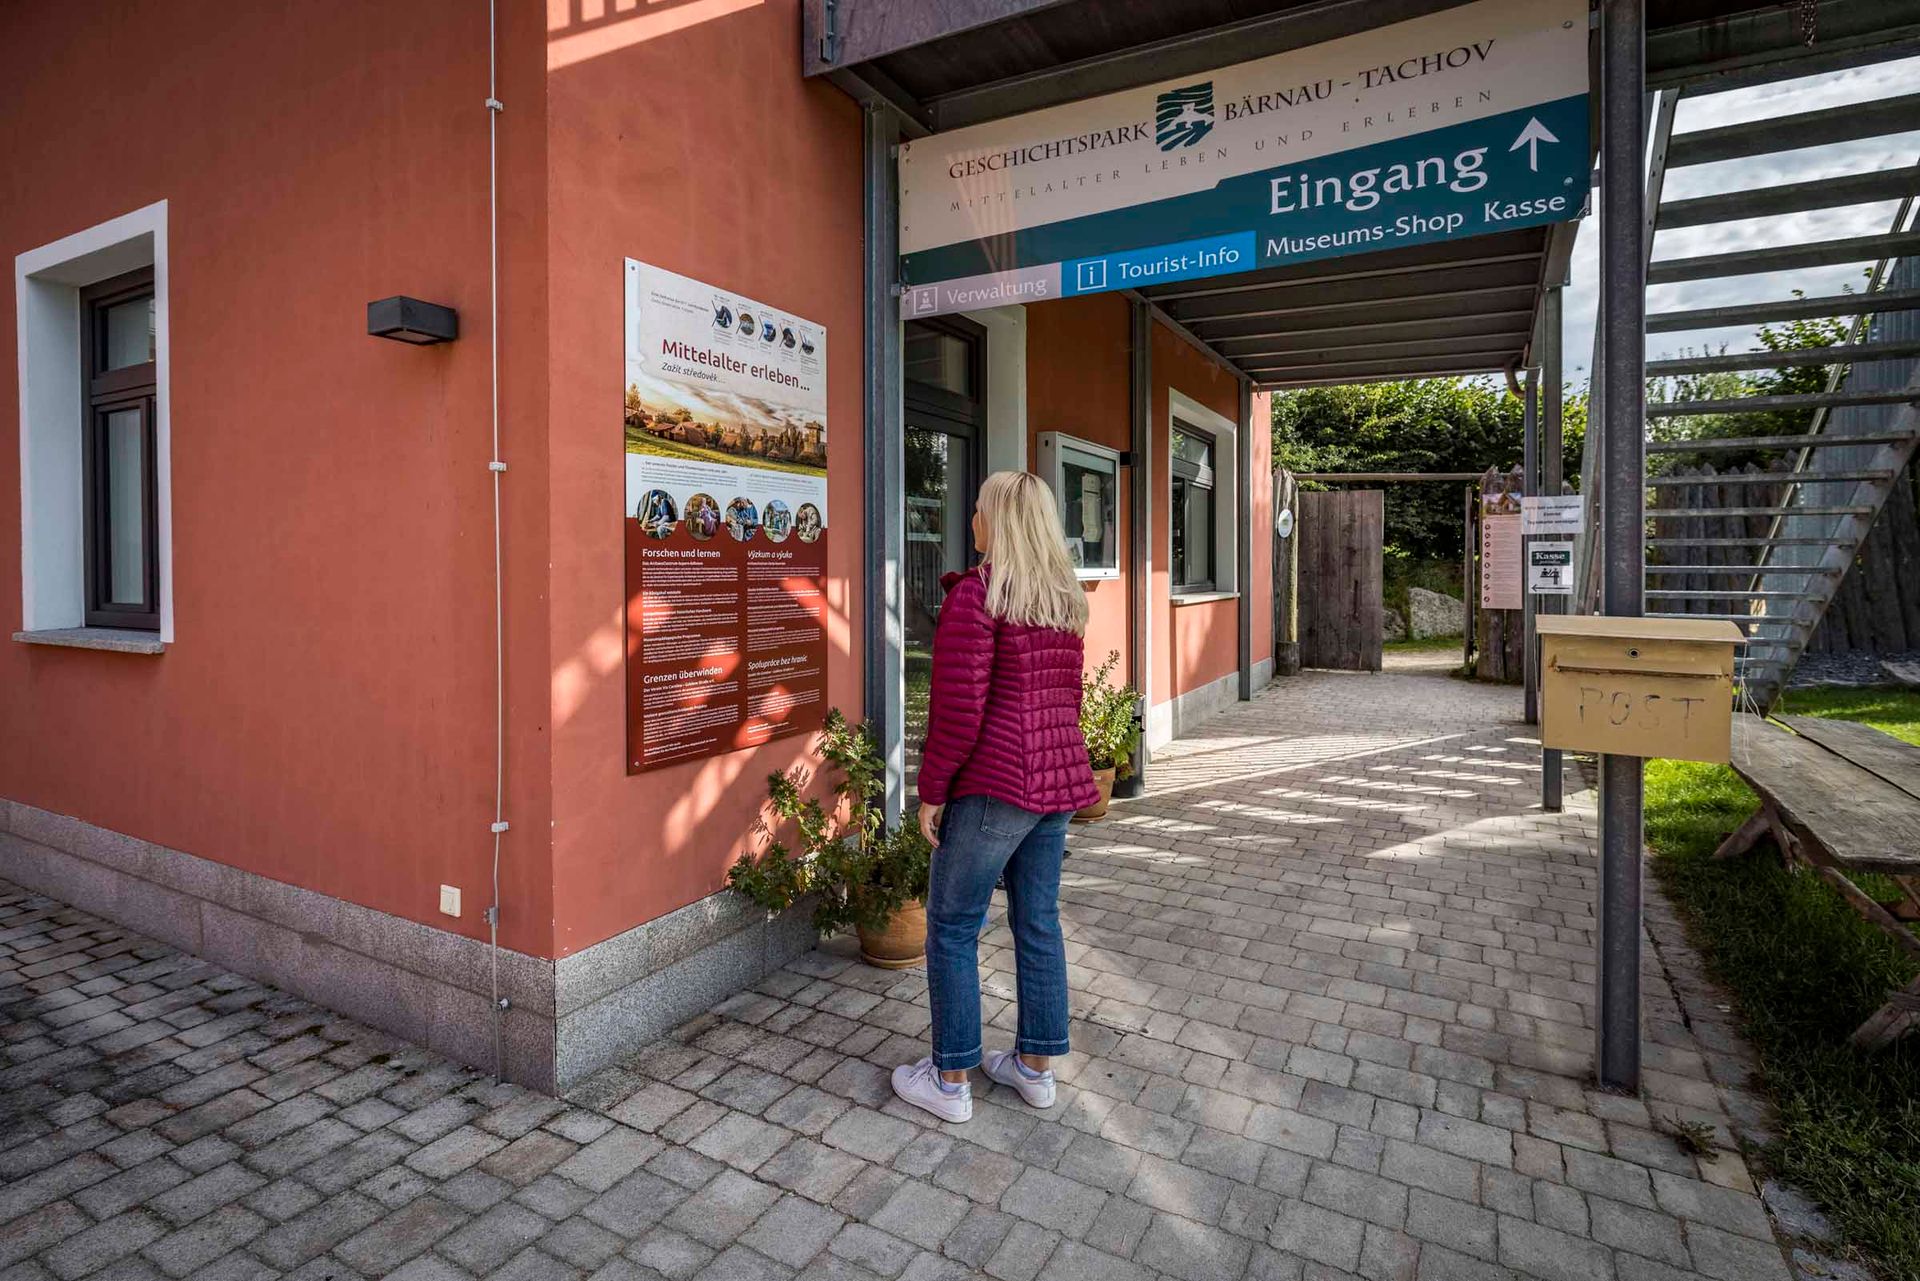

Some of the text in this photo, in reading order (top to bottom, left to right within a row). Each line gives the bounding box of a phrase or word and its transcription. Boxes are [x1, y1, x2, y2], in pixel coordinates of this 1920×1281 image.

[949, 122, 1149, 179] GESCHICHTSPARK
[1223, 79, 1333, 122] BÄRNAU
[1358, 38, 1496, 91] TACHOV
[949, 89, 1493, 212] MITTELALTER LEBEN UND ERLEBEN
[1269, 146, 1489, 216] Eingang
[1266, 194, 1567, 258] Museums-Shop Kasse
[1118, 245, 1240, 280] Tourist-Info
[946, 276, 1048, 305] Verwaltung
[661, 338, 748, 374] Mittelalter
[642, 548, 721, 558] Forschen und lernen
[747, 550, 771, 559] Výzkum
[1535, 552, 1565, 560] Kasse
[643, 672, 677, 684] Grenzen
[679, 666, 723, 681] überwinden
[747, 658, 780, 670] Spolupráce
[780, 657, 791, 665] bez
[1579, 687, 1705, 739] POST
